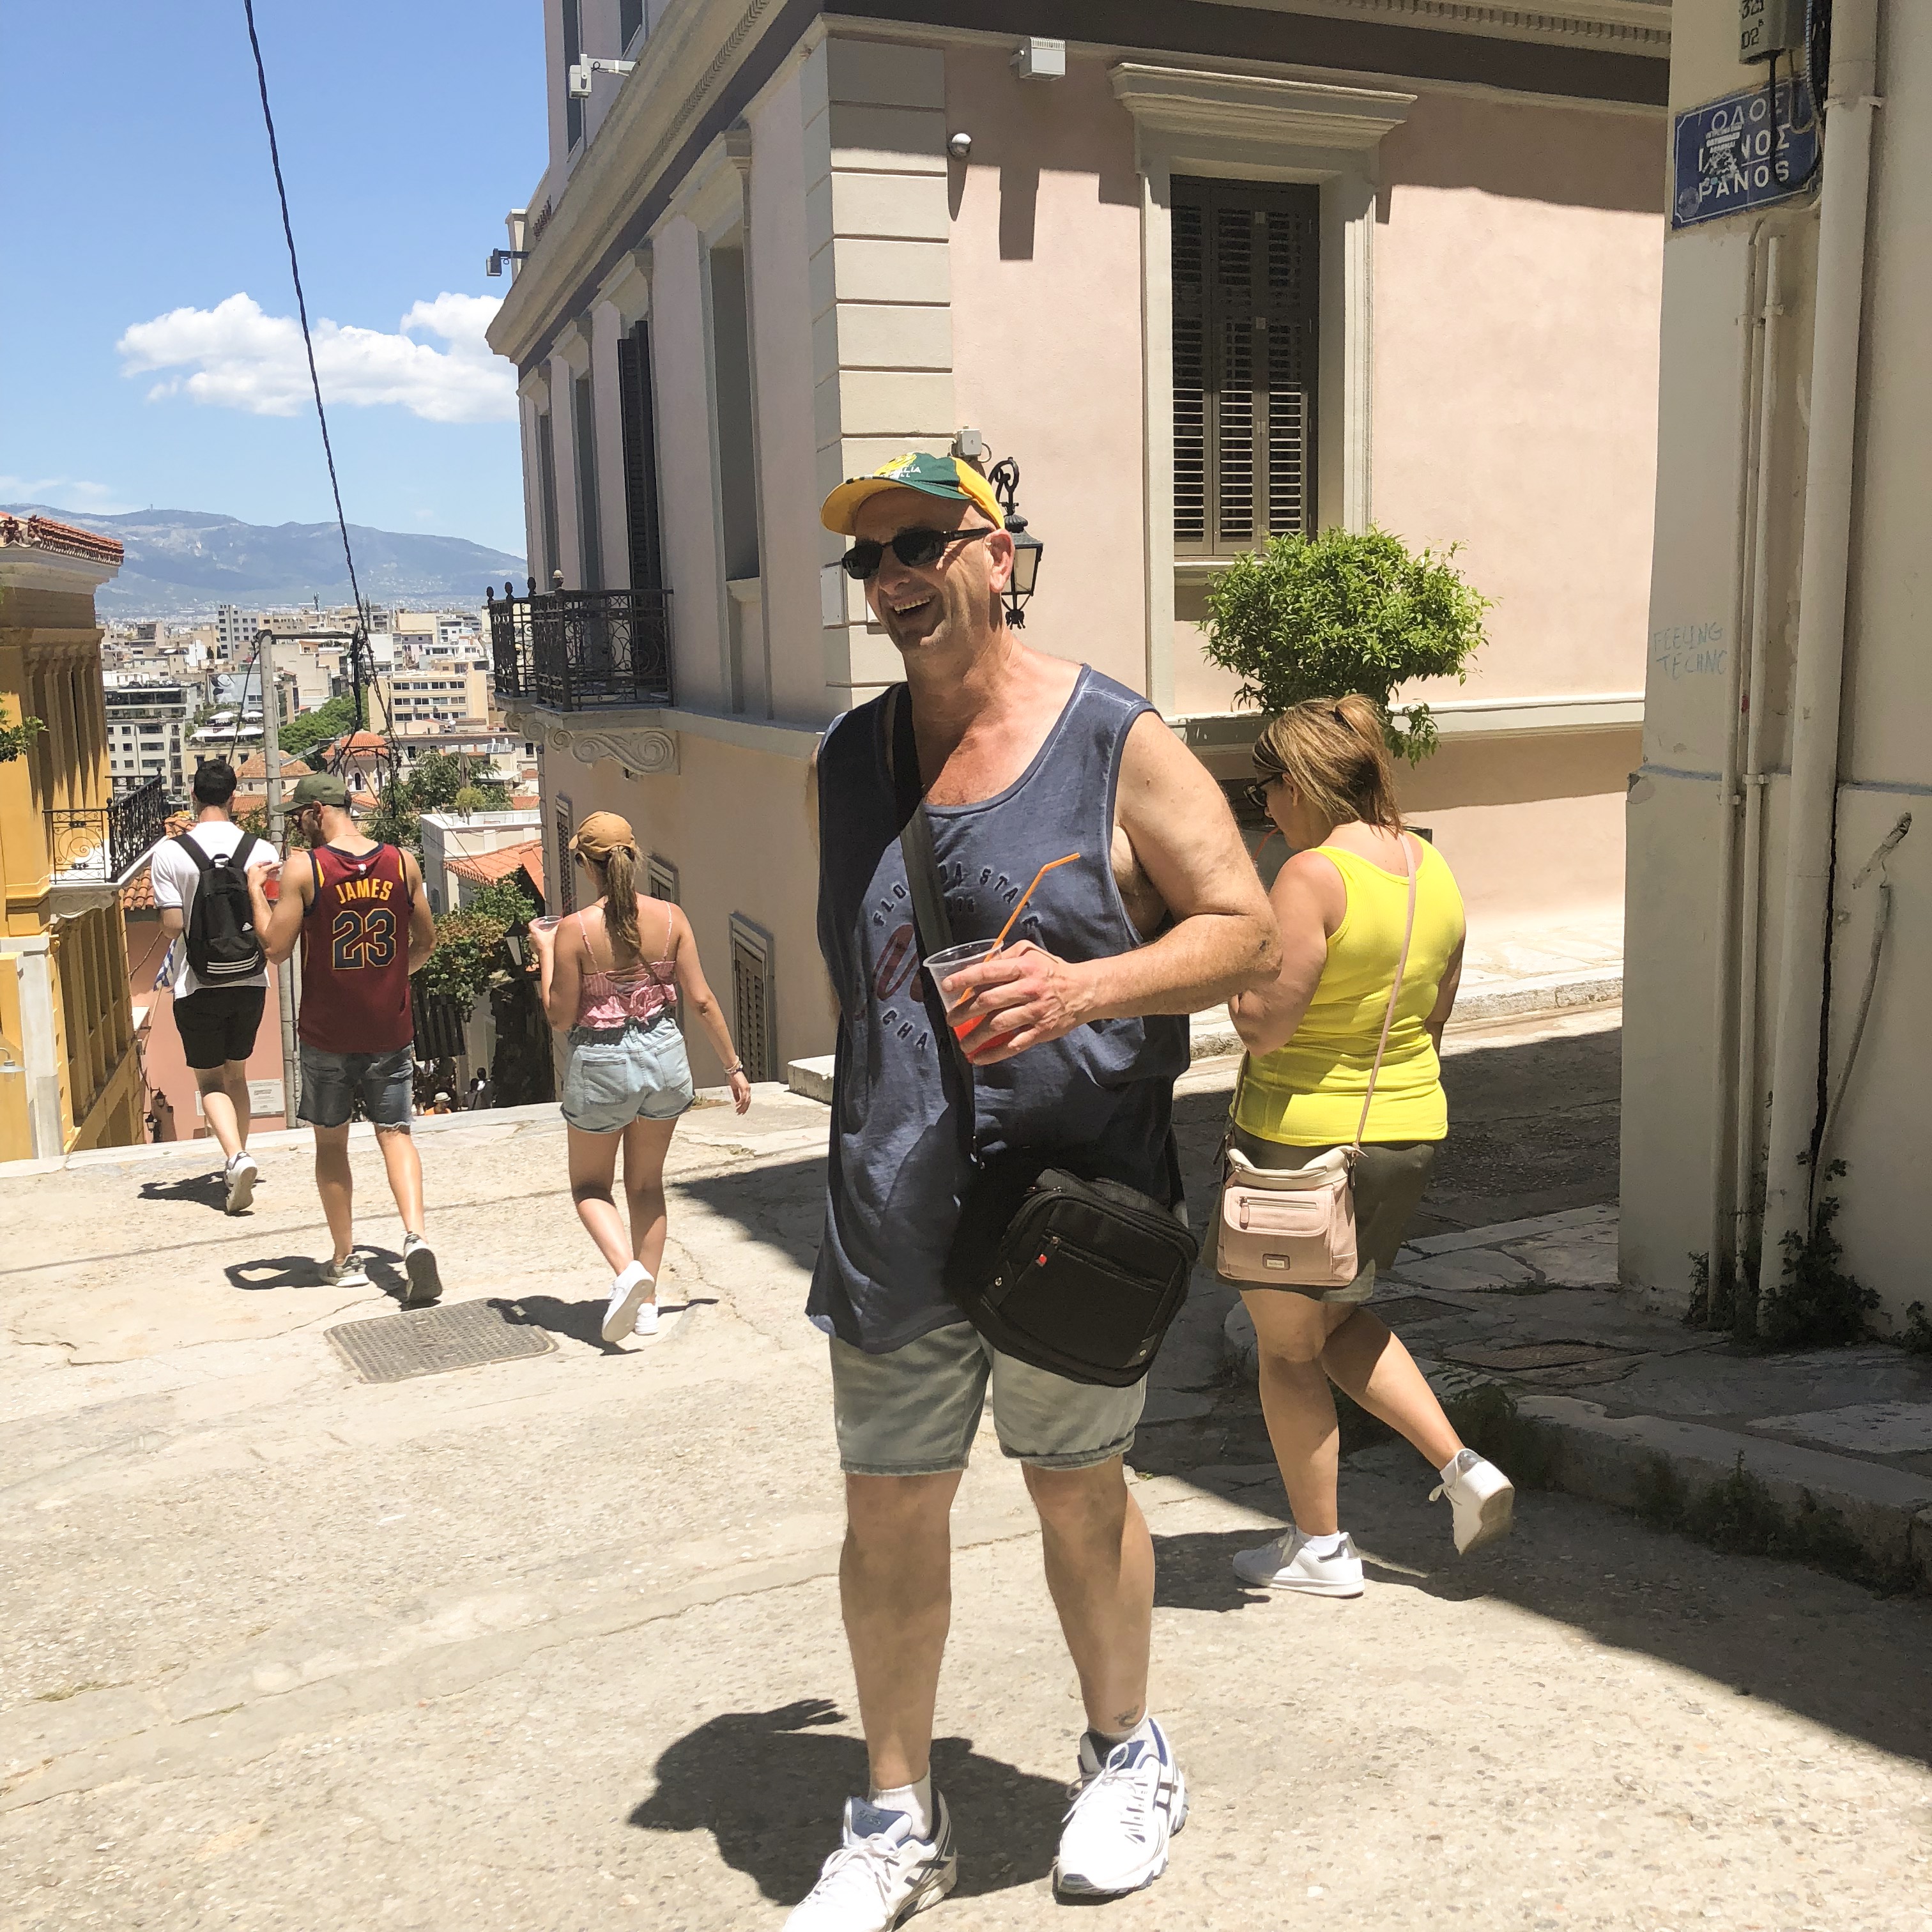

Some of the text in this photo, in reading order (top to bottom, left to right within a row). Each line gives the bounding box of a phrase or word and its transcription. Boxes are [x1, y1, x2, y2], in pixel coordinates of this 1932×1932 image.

[1698, 160, 1790, 203] PANOS
[334, 877, 394, 905] JAMES
[332, 907, 397, 970] 23
